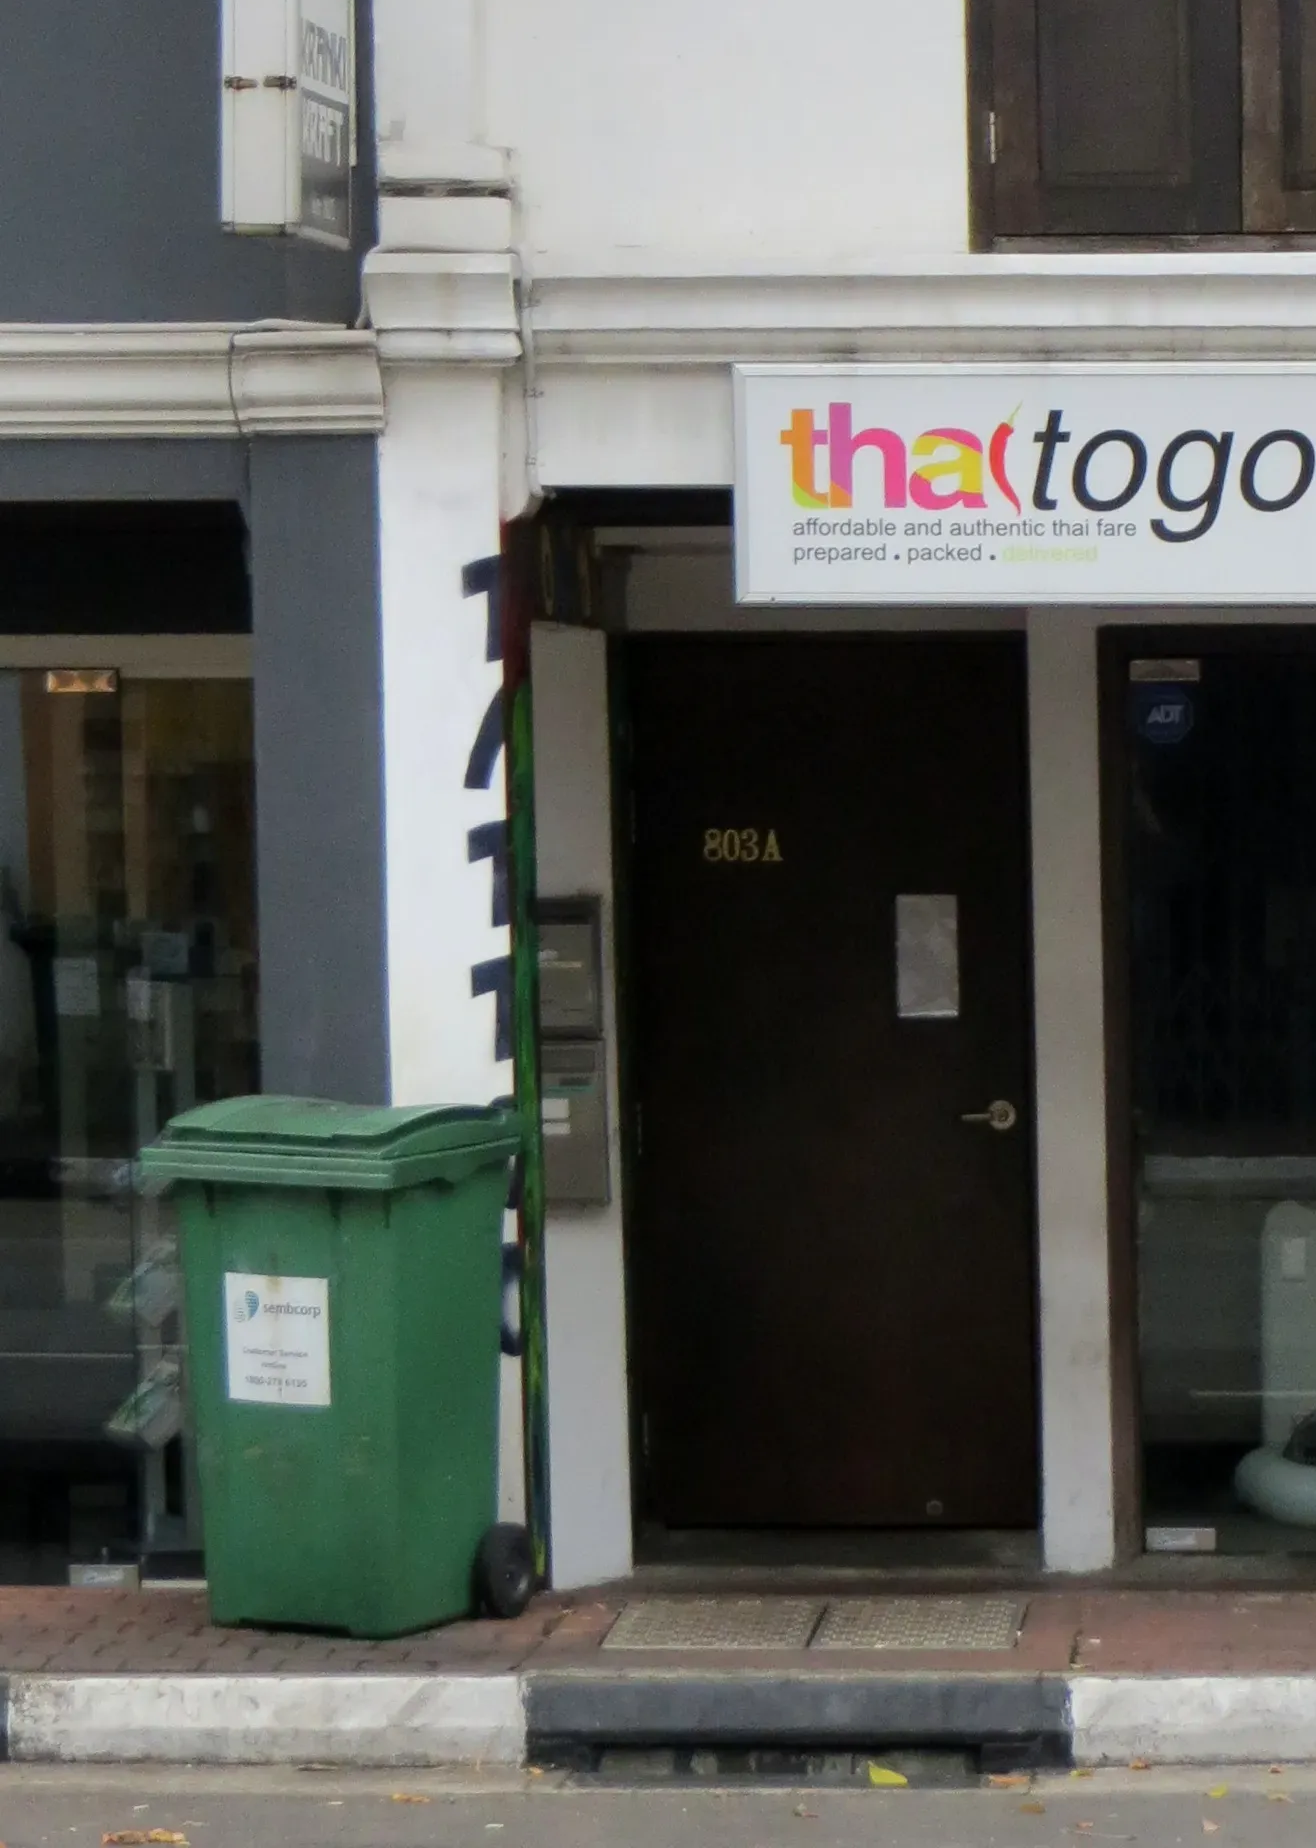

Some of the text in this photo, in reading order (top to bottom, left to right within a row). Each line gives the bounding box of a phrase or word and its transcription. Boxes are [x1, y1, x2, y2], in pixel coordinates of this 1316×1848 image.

[792, 518, 1137, 537] affordable and authentic thai fare
[793, 543, 886, 565] prepared
[907, 543, 982, 565] packed
[1147, 704, 1184, 724] ADT
[704, 829, 783, 862] 803A
[263, 1301, 321, 1319] sembcorp
